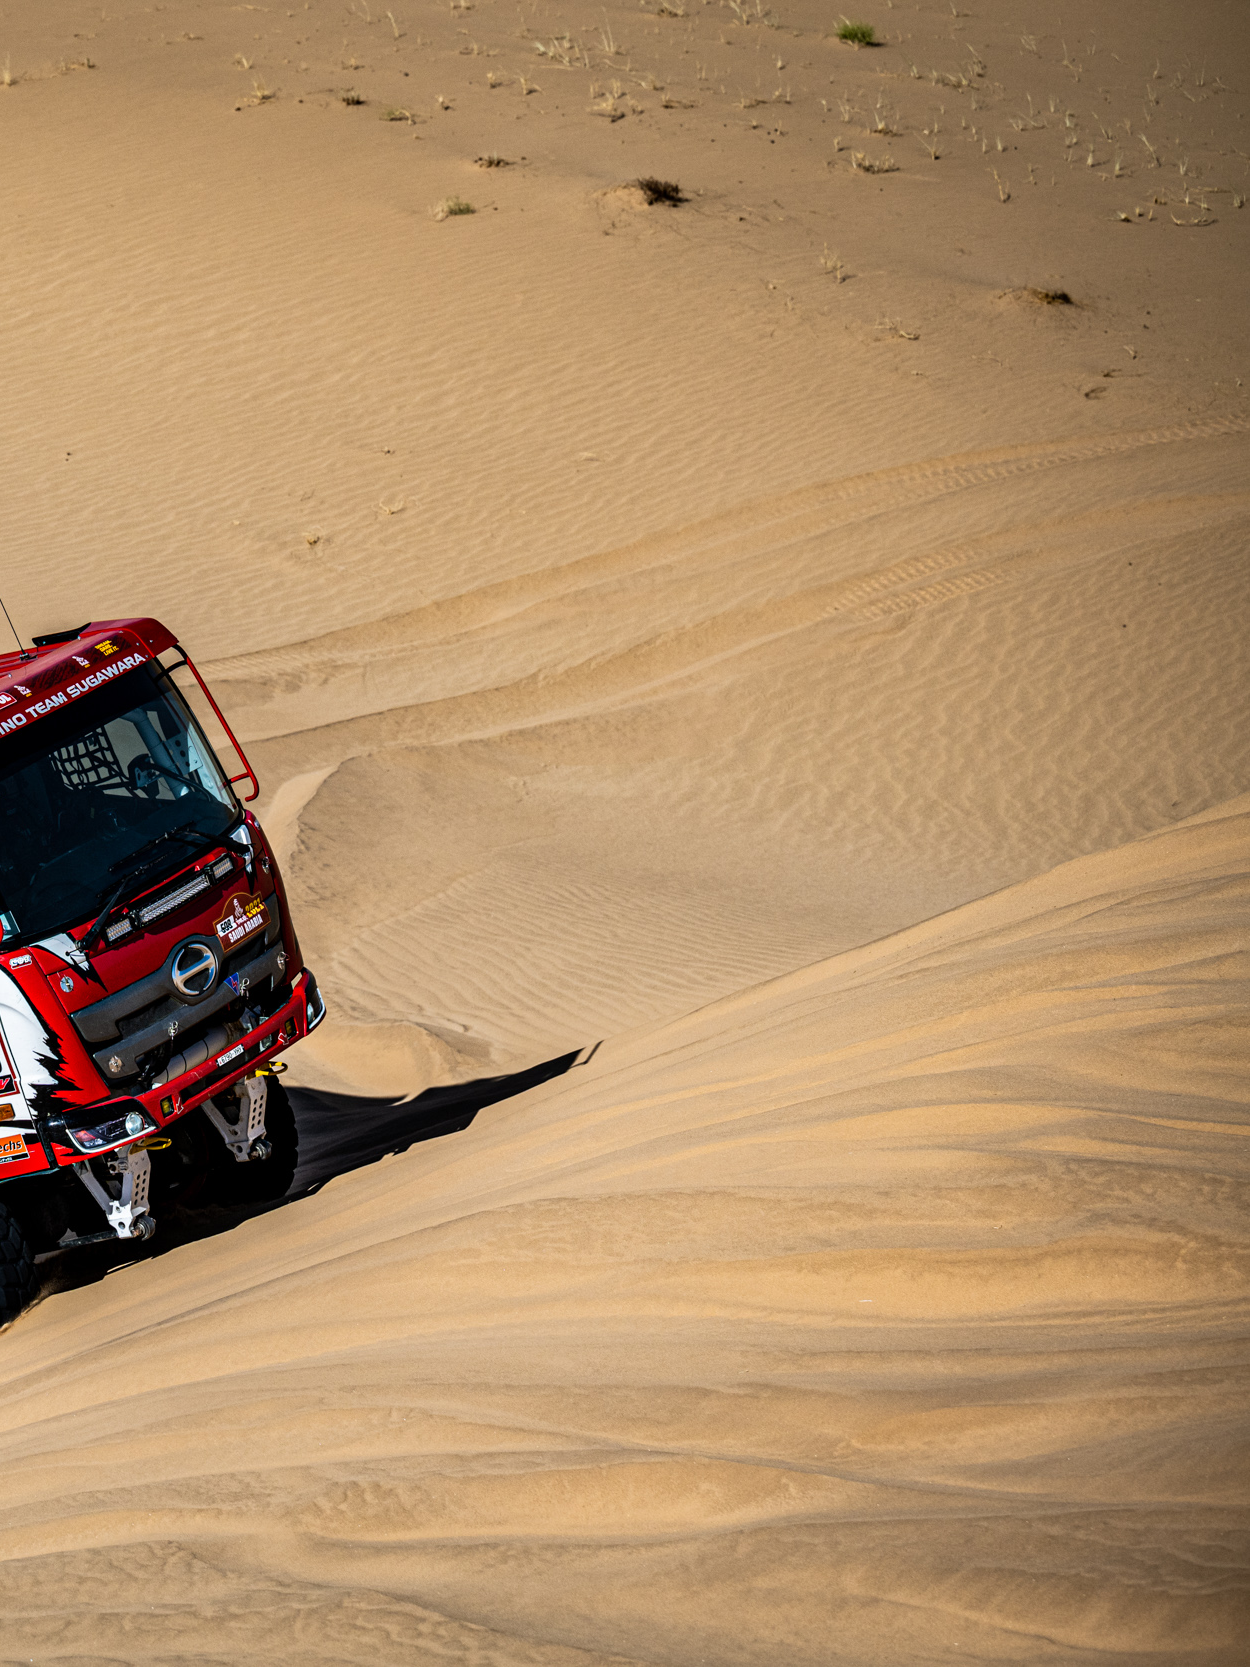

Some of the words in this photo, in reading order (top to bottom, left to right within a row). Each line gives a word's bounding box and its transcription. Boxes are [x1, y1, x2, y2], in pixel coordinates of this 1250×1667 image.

[26, 692, 68, 718] TEAM
[67, 653, 146, 698] SUGAWARA
[228, 926, 246, 943] SAUDI
[244, 914, 264, 934] ARABIA
